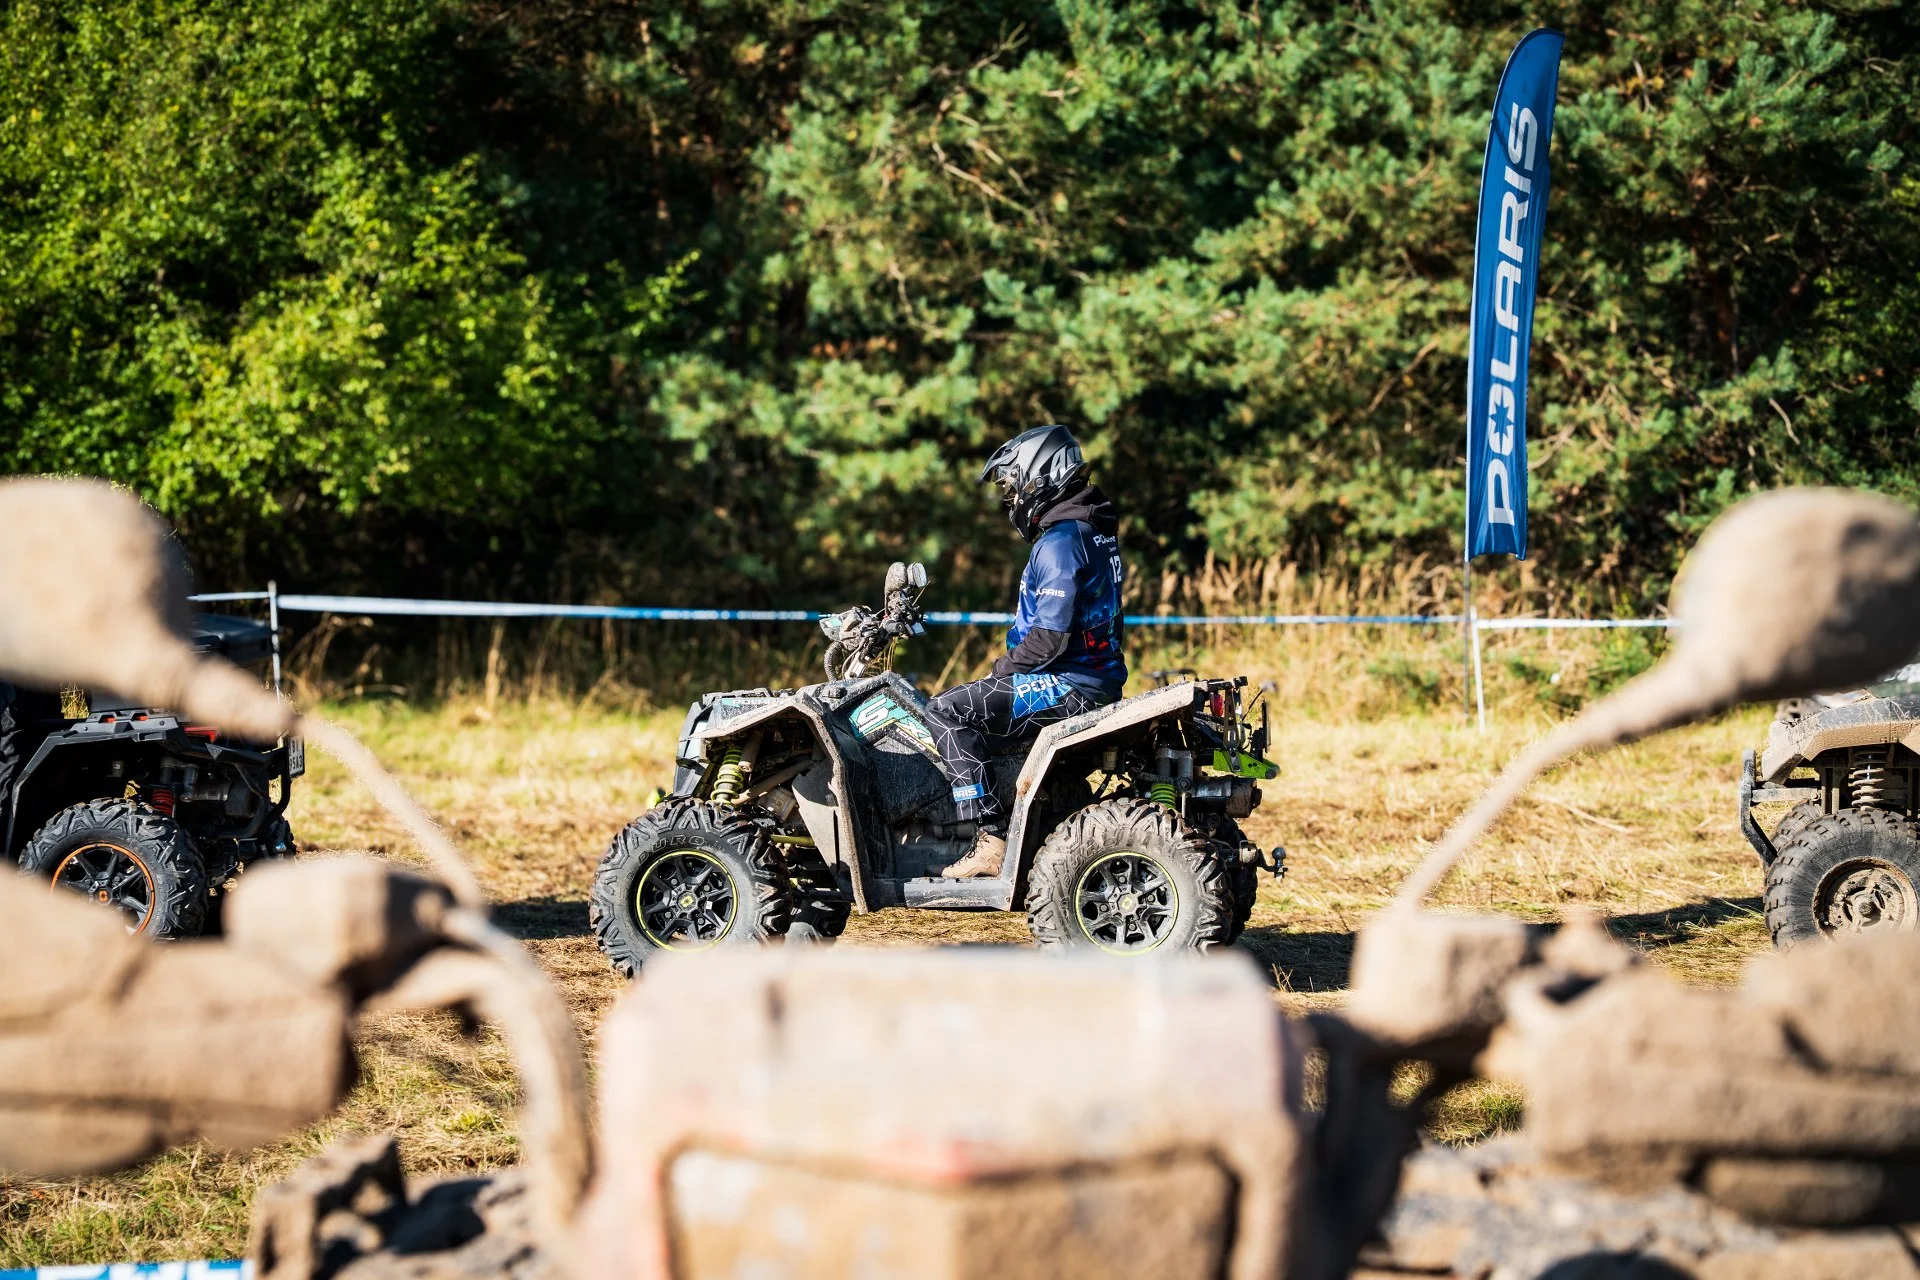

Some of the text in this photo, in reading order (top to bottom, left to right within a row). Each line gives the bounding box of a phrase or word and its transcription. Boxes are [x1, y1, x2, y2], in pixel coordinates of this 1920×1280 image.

[1487, 102, 1538, 526] POLARIS
[895, 727, 926, 751] 1000
[638, 834, 705, 864] DURO
